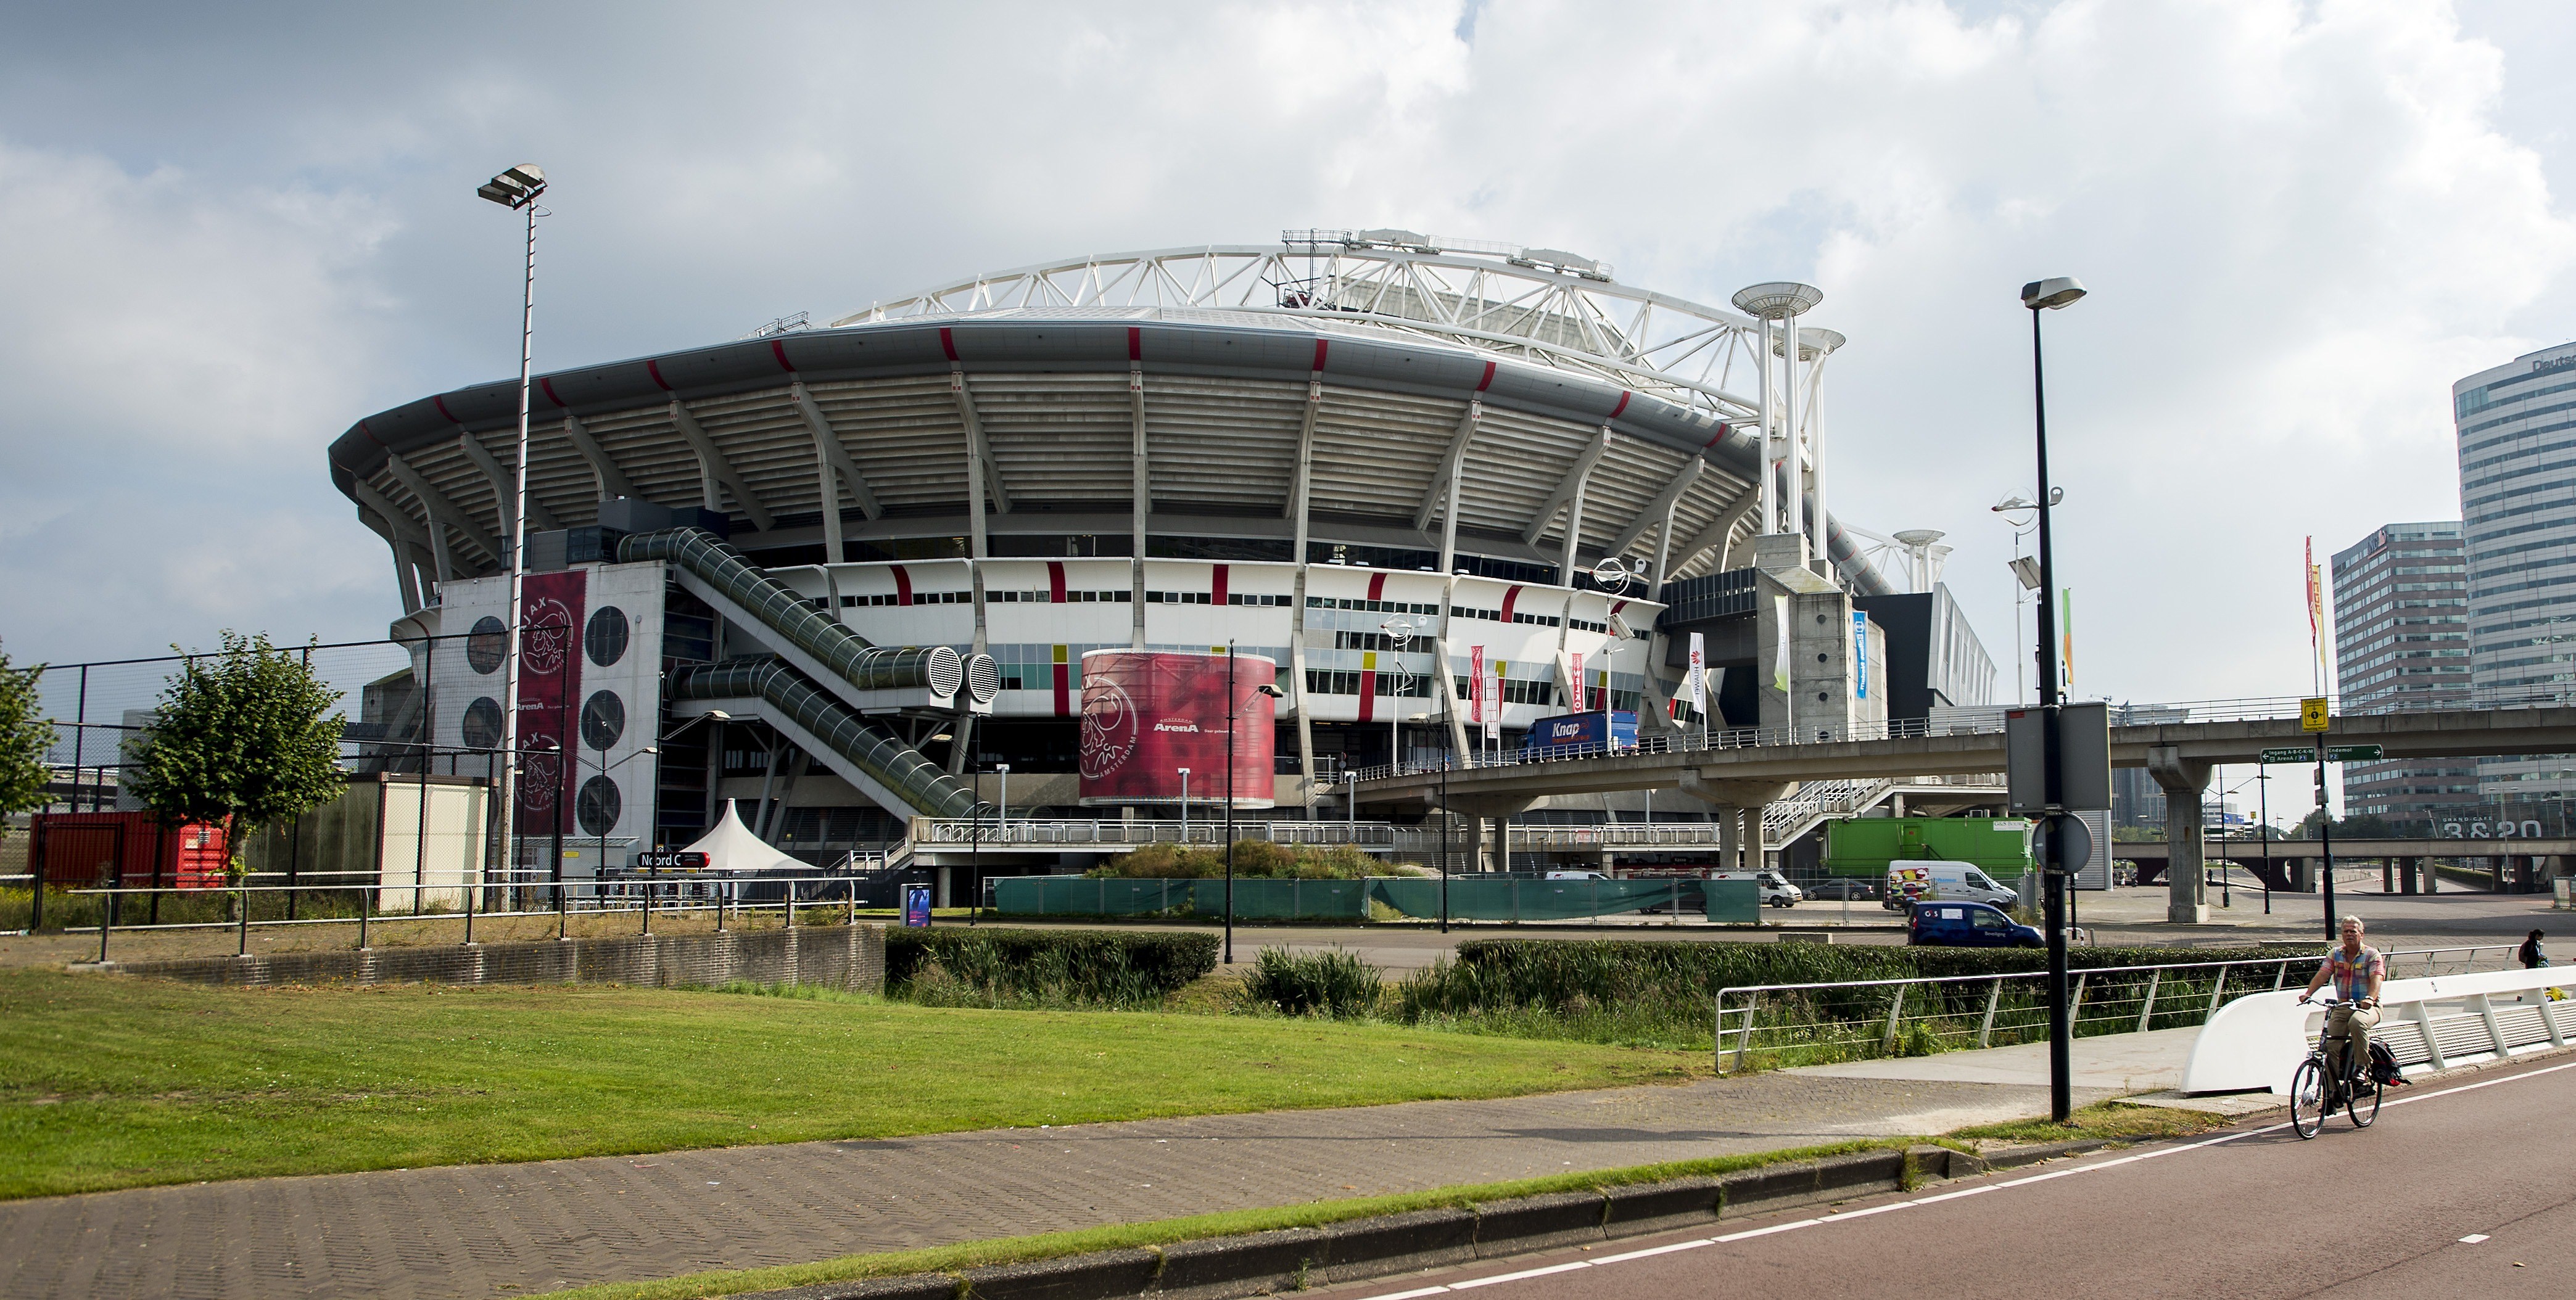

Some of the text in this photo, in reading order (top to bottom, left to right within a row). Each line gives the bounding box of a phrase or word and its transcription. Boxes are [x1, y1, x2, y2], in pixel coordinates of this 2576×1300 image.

[1153, 723, 1199, 733] ArenA
[1552, 722, 1580, 739] Knap
[1099, 736, 1137, 778] AMSTERDAM
[2443, 820, 2542, 838] 3&20
[674, 854, 681, 866] C
